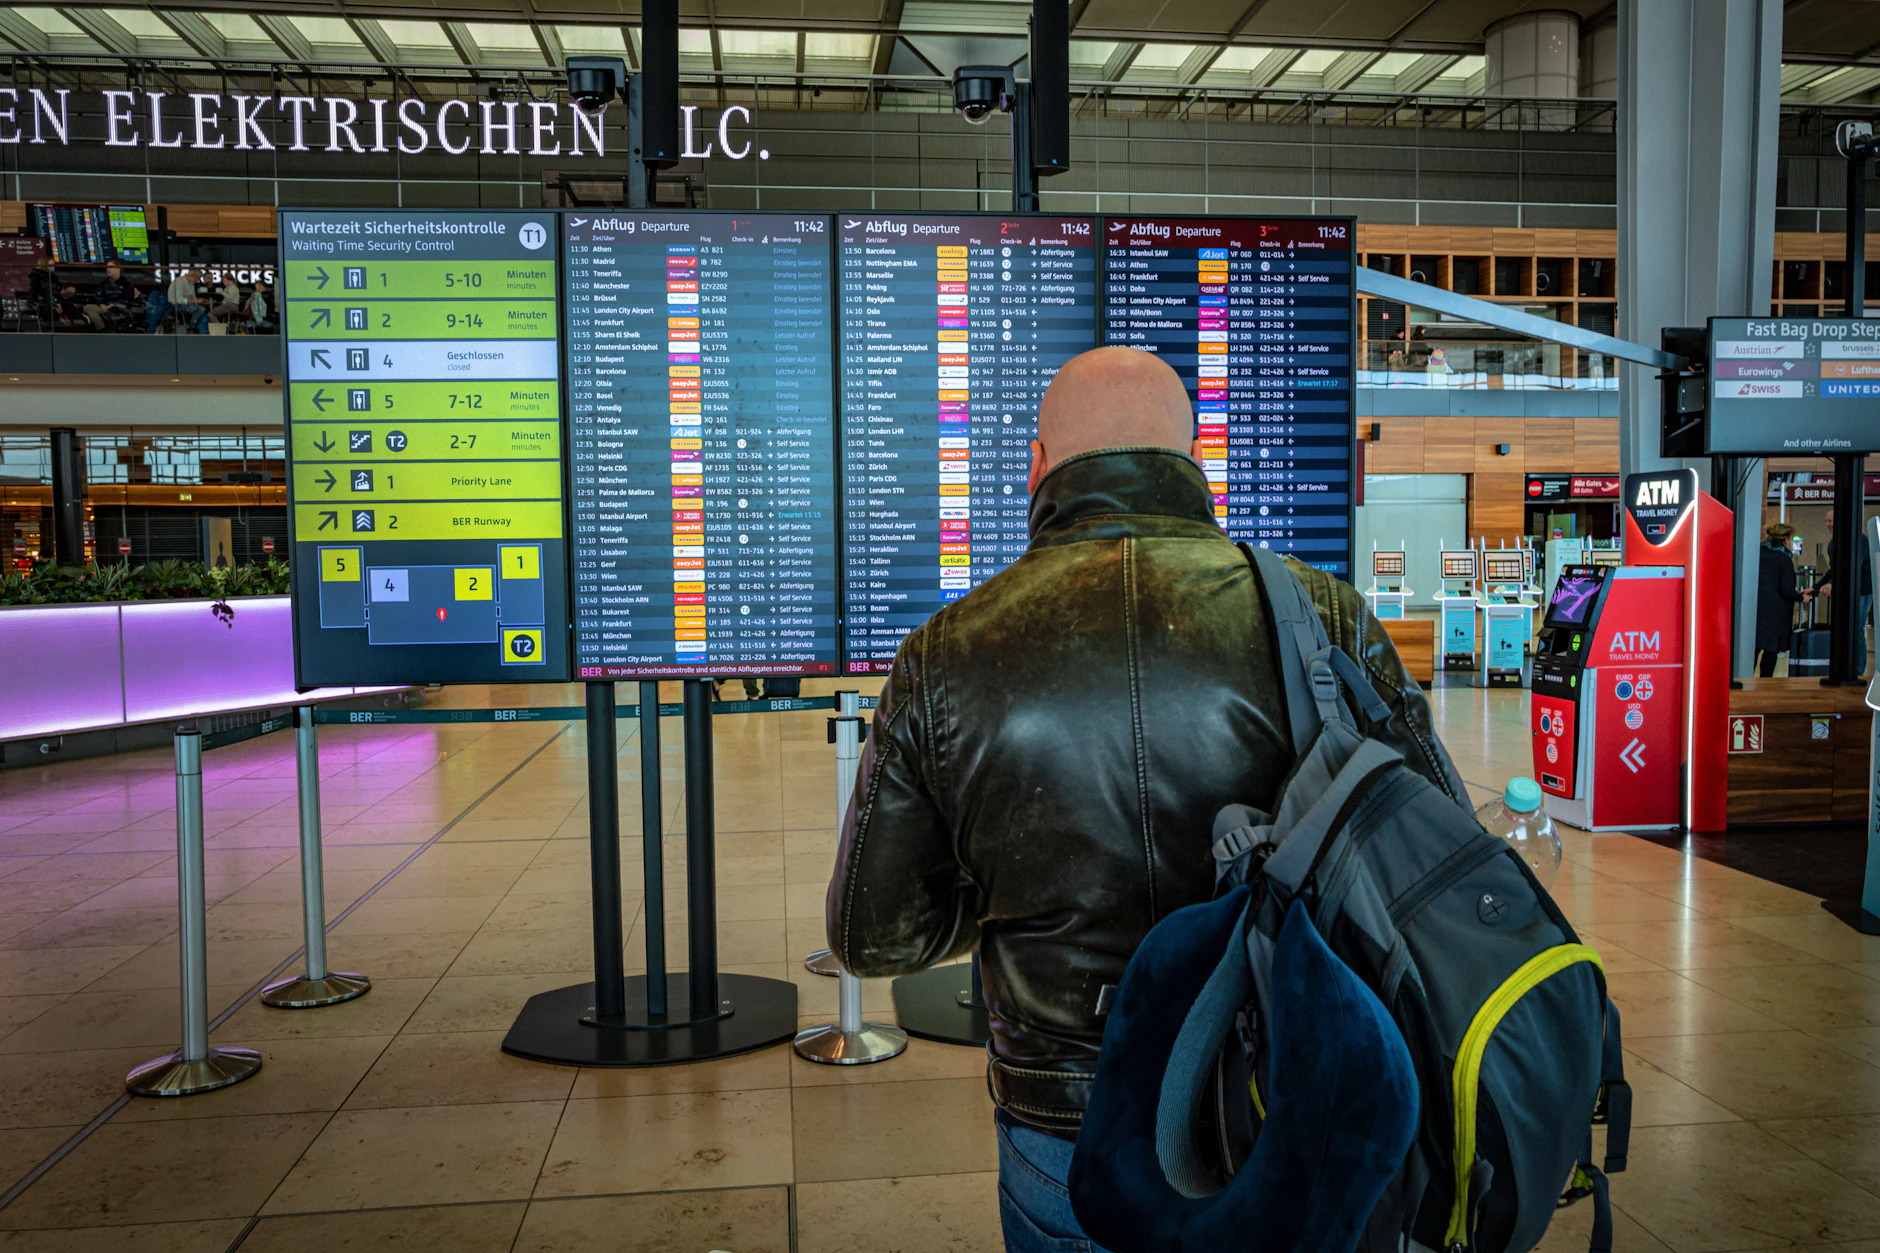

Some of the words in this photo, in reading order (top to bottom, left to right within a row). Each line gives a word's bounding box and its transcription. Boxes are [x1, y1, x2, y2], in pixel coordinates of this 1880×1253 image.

[102, 90, 606, 157] ELEKTRISCHEN
[291, 222, 360, 234] Wartezeit
[365, 221, 506, 234] Sicherheitskontrolle
[524, 230, 541, 243] T1
[592, 219, 635, 233] Abflug
[641, 222, 689, 233] Departure
[732, 220, 737, 231] 1
[794, 221, 824, 232] 11:42
[866, 221, 907, 236] Abflug
[913, 224, 960, 235] Departure
[1001, 223, 1008, 234] 2
[1061, 223, 1090, 234] 11:42
[1130, 223, 1170, 238] Abflug
[1176, 227, 1221, 238] Departure
[1260, 226, 1267, 236] 3
[1318, 227, 1345, 238] 11:42
[292, 240, 334, 253] Waiting
[338, 240, 364, 251] Time
[368, 240, 411, 253] Security
[415, 240, 454, 251] Control
[381, 273, 387, 287] 1
[446, 273, 482, 287] 5-10
[506, 270, 546, 278] Minuten
[382, 314, 391, 328] 2
[446, 314, 483, 328] 9-14
[508, 311, 547, 319] Minuten
[1747, 322, 1776, 336] Fast
[1781, 323, 1807, 340] Bag
[1813, 323, 1847, 340] Drop
[1733, 346, 1771, 354] Austrian
[383, 355, 393, 368] 4
[447, 351, 504, 360] Geschlossen
[1739, 368, 1783, 378] Eurowings
[1828, 385, 1880, 393] UNITED
[385, 395, 393, 408] 5
[449, 395, 482, 408] 7-12
[510, 392, 549, 400] Minuten
[388, 436, 404, 447] T2
[450, 435, 476, 448] 2-7
[512, 432, 550, 440] Minuten
[387, 476, 394, 488] 1
[452, 477, 486, 487] Priority
[490, 477, 511, 485] Lane
[1636, 480, 1679, 506] ATM
[389, 516, 398, 529] 2
[453, 517, 472, 525] BER
[475, 517, 511, 527] Runway
[337, 558, 345, 572] 5
[518, 556, 523, 569] 1
[385, 579, 394, 592] 4
[469, 577, 478, 590] 2
[514, 640, 532, 652] T2
[1610, 631, 1660, 652] ATM
[581, 668, 602, 676] BER
[738, 665, 772, 674] Abfluggates
[850, 662, 869, 672] BER
[770, 700, 791, 710] BER
[858, 698, 869, 707] ER
[350, 712, 372, 722] BER
[494, 710, 516, 720] BER
[262, 720, 273, 734] BER
